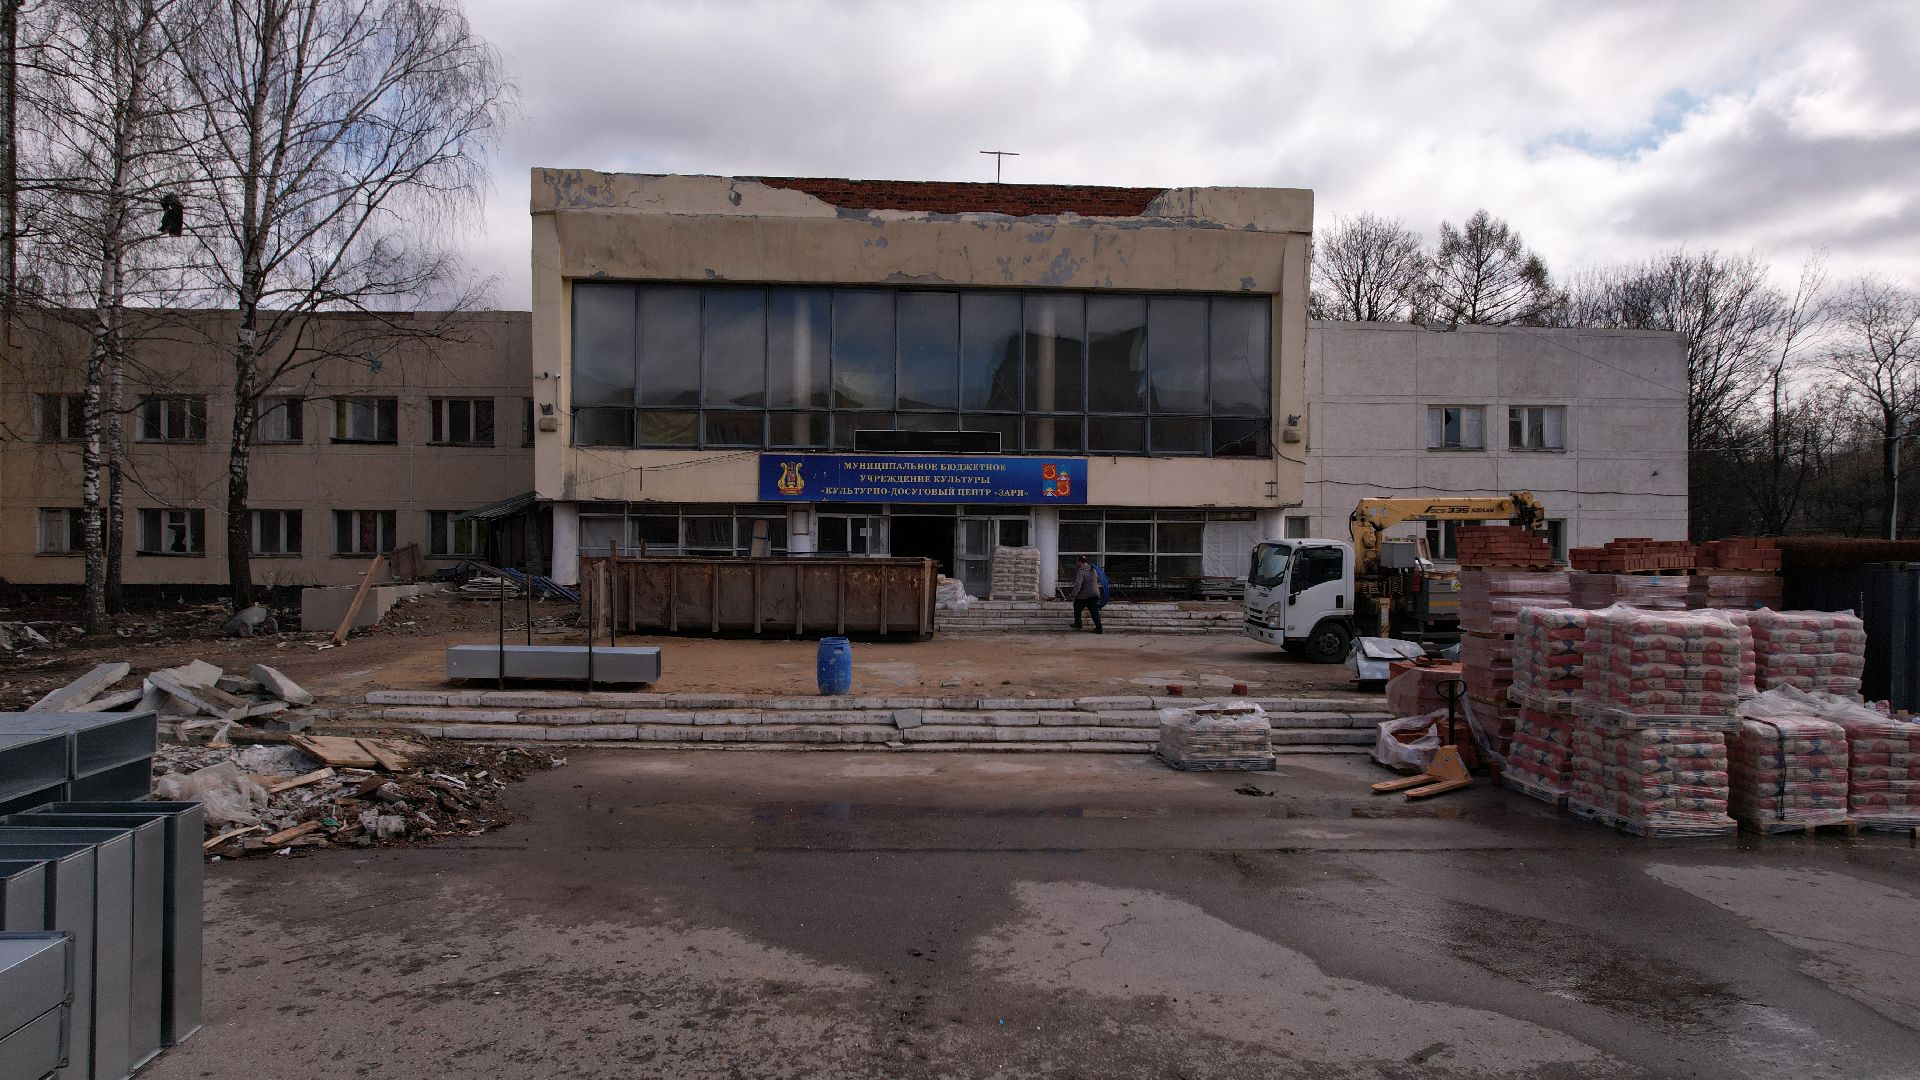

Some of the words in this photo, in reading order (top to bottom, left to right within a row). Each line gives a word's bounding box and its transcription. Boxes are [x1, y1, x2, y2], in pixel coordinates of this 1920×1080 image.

[844, 462, 938, 471] МУНИЦИПАЛЬНОЕ
[940, 463, 1007, 472] БЮДЖЕТНОЕ
[860, 474, 931, 483] УЧРЕЖДЕНИЕ
[933, 475, 991, 484] КУЛЬТУРЫ
[957, 488, 992, 497] ЦЕНТР
